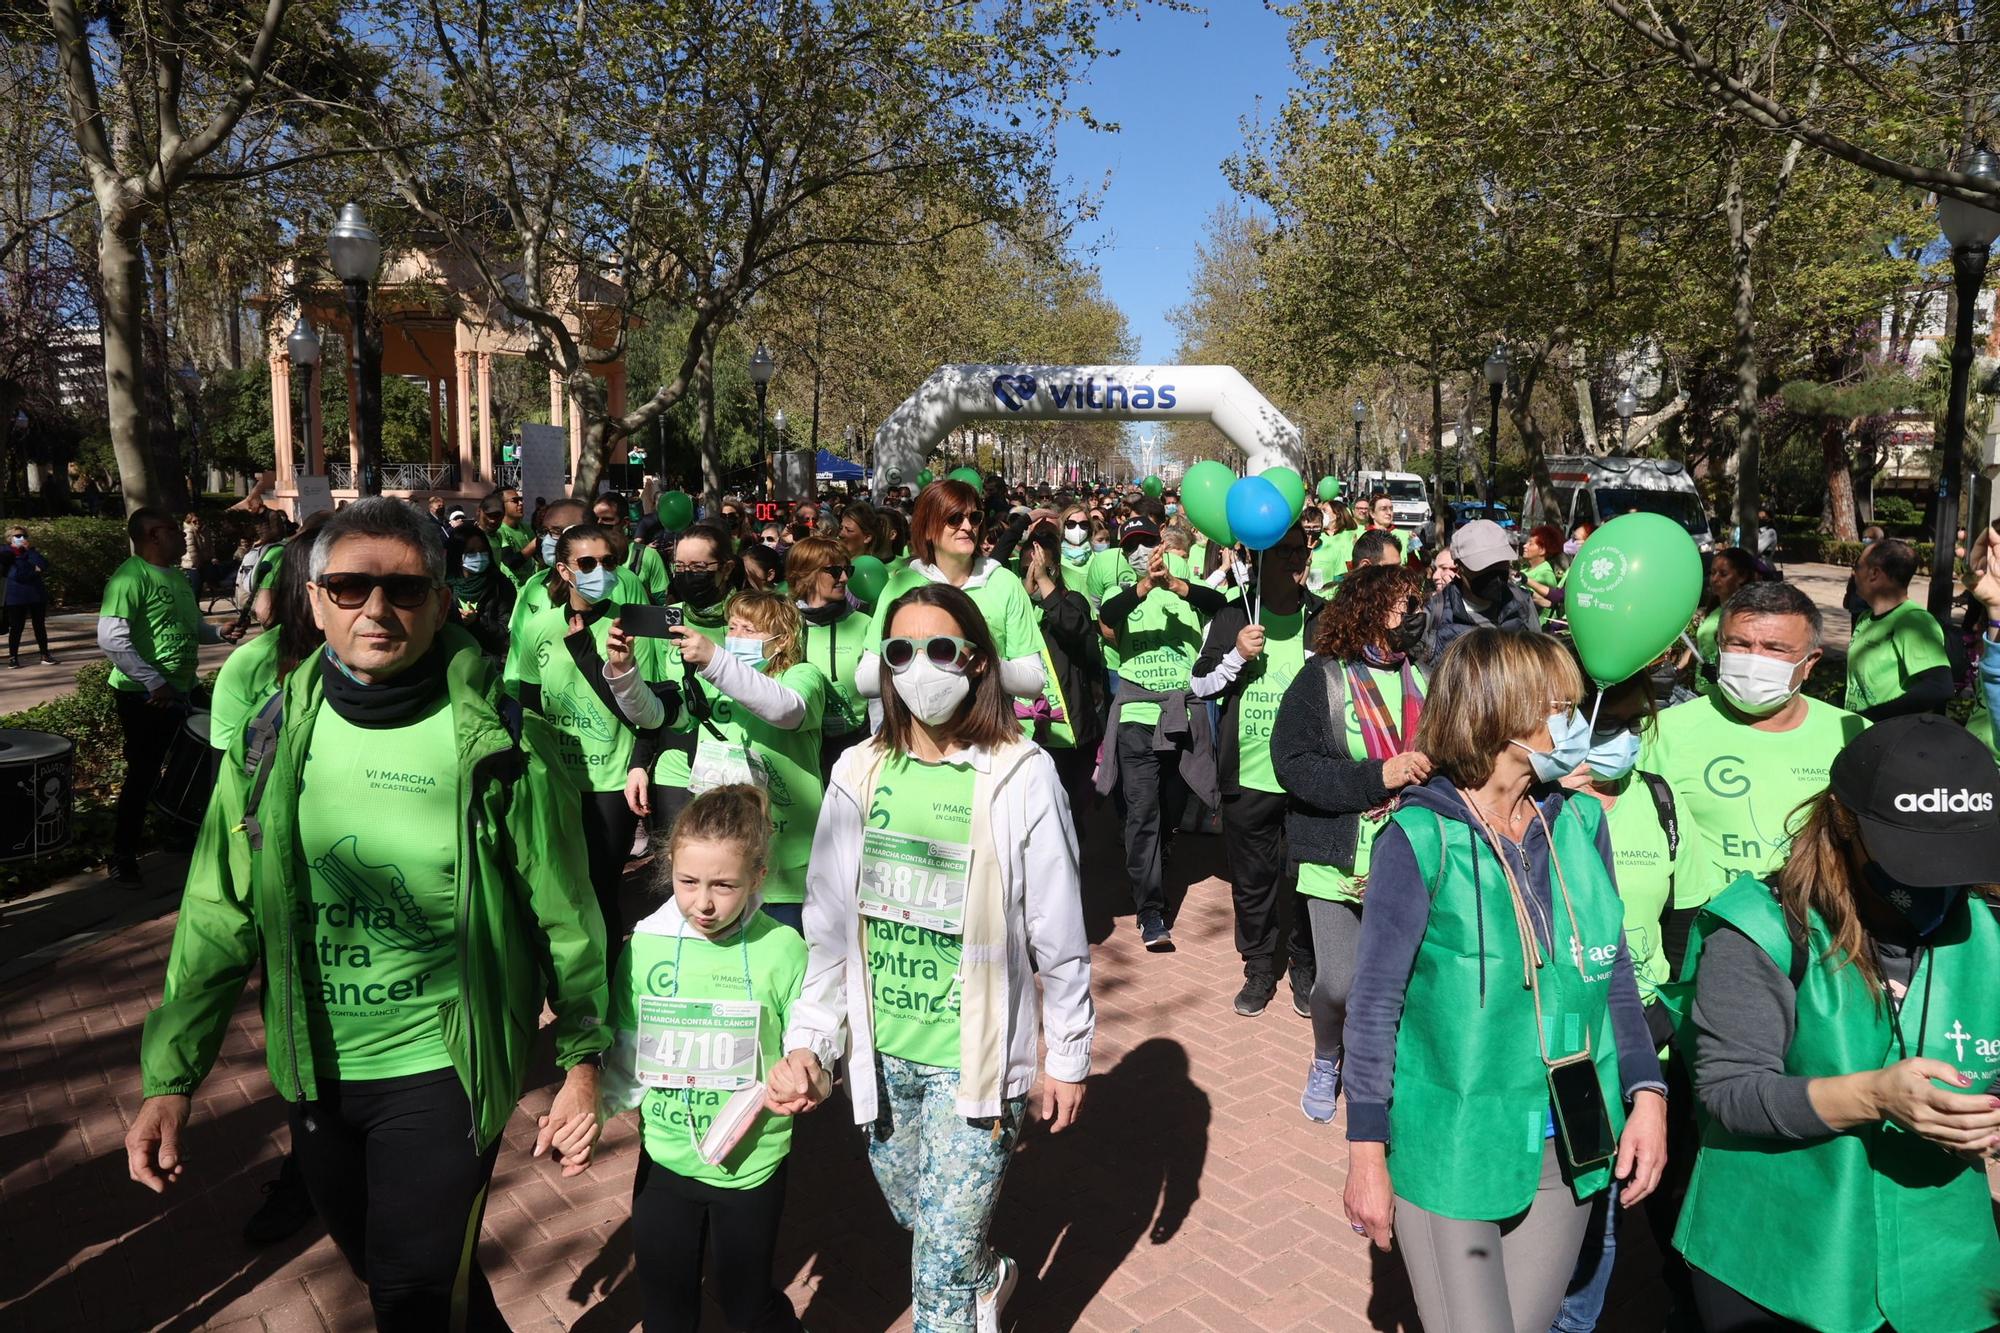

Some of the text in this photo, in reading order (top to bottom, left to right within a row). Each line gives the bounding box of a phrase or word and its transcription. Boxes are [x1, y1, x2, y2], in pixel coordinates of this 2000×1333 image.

[1050, 377, 1177, 410] vithas
[1133, 651, 1184, 666] marcha
[1134, 666, 1178, 679] contra
[1246, 690, 1284, 703] marc
[547, 712, 592, 730] archa
[1244, 706, 1280, 721] cont
[559, 731, 581, 746] tra
[1245, 722, 1258, 737] el
[560, 748, 608, 766] áncer
[366, 769, 436, 787] VI MARCHA
[1802, 768, 1829, 776] MARC
[382, 783, 427, 794] CASTELLÓN
[932, 802, 973, 816] VI MARC
[1894, 787, 1993, 813] adidas
[1621, 850, 1660, 859] MARCHA
[1721, 833, 1762, 859] En
[871, 848, 900, 859] MARCHA
[900, 852, 927, 865] CONTRA
[936, 860, 965, 870] CÁNCER
[874, 861, 948, 911] 3874
[301, 896, 396, 929] archa
[303, 935, 372, 968] ntra
[1587, 944, 1617, 962] ae
[1582, 975, 1597, 983] DA,
[881, 984, 960, 1018] cánce
[331, 1009, 359, 1018] CONTRA
[359, 1009, 368, 1017] EL
[370, 1006, 400, 1017] CÁNCER
[649, 1015, 680, 1025] MARCHA
[681, 1018, 713, 1027] CONTRA
[713, 1018, 722, 1026] EL
[723, 1018, 755, 1028] CÁNCER
[655, 1030, 735, 1070] 4710
[1975, 1038, 2000, 1056] ae
[652, 1101, 667, 1121] el
